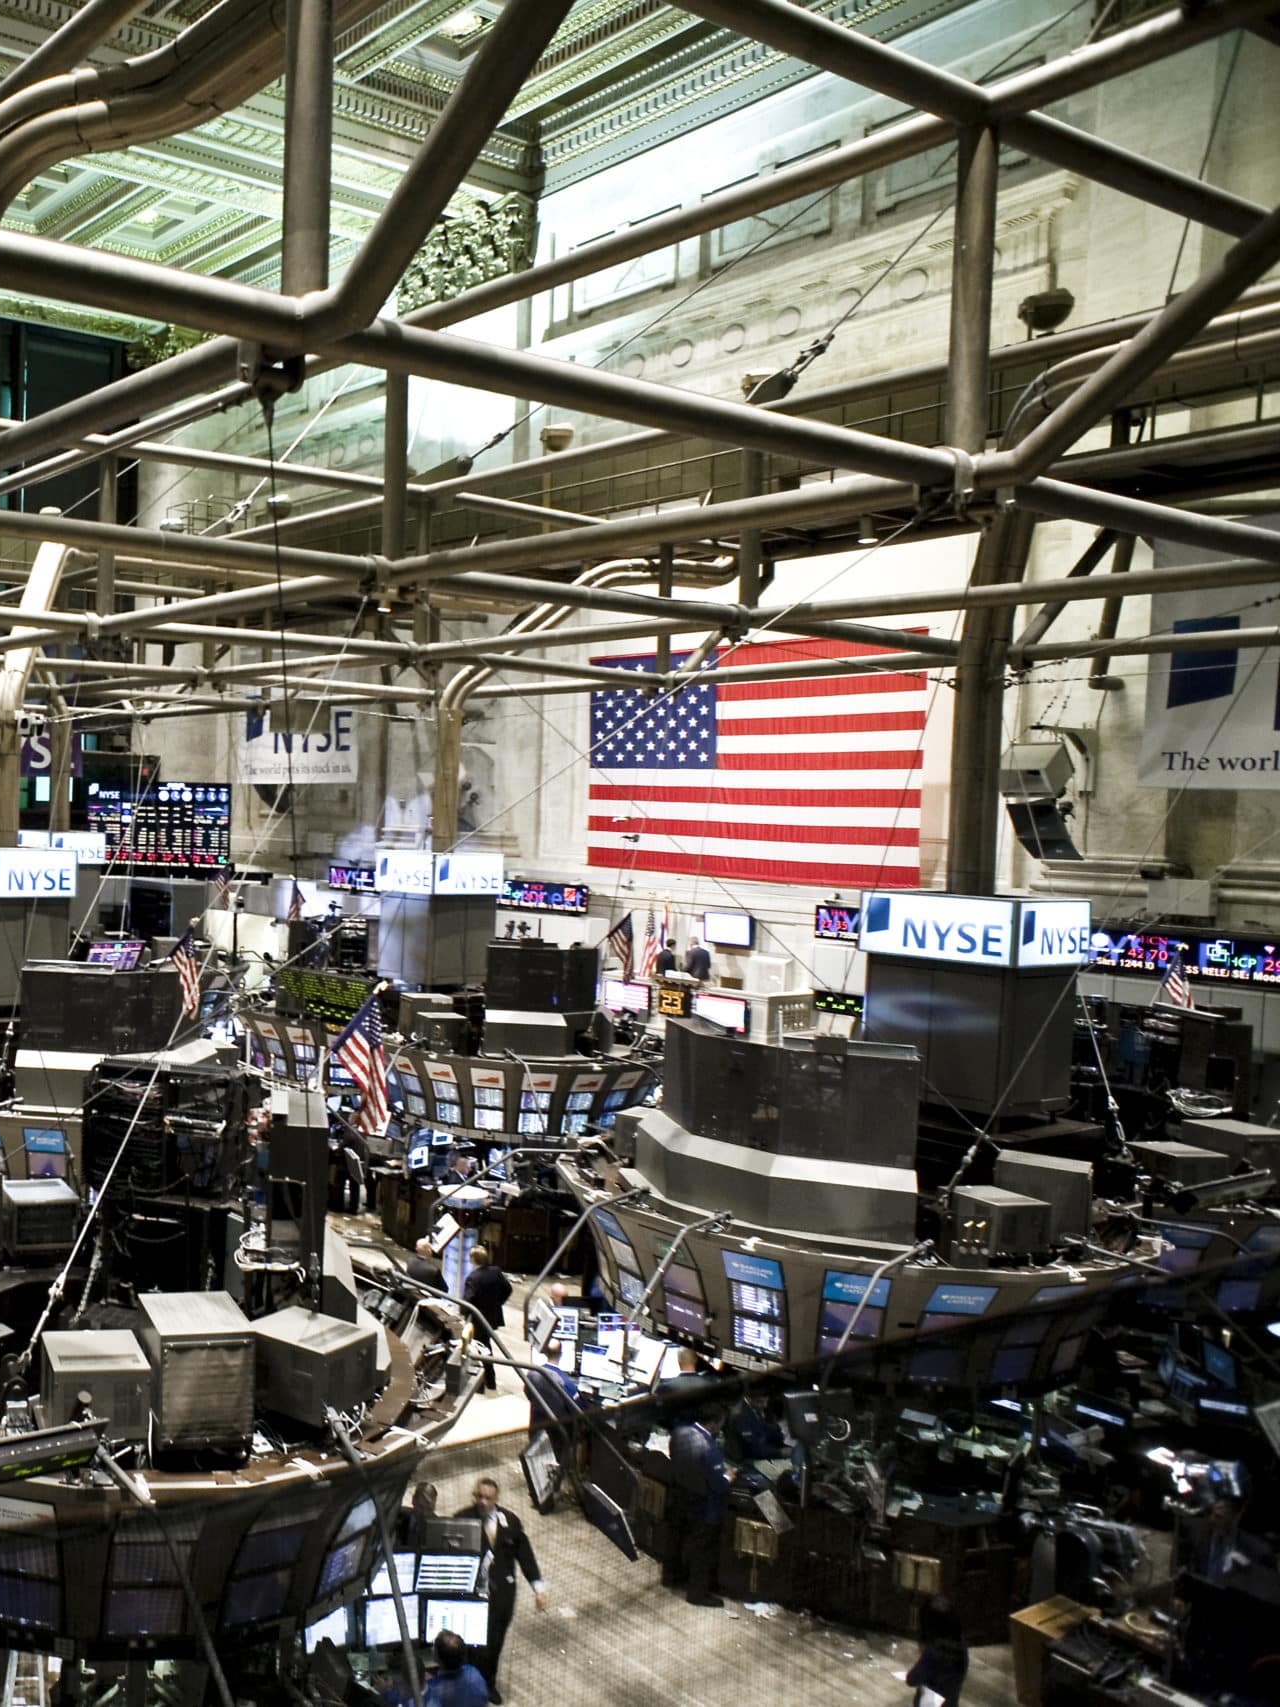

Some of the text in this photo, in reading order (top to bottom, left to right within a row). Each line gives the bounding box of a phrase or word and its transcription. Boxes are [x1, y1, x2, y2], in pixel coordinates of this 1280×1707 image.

[1161, 751, 1210, 771] The
[99, 790, 120, 799] NYSE
[79, 848, 105, 859] YSE
[8, 868, 71, 891] NYSE
[393, 869, 431, 888] NYSE
[455, 870, 499, 889] NYSE
[903, 917, 1003, 957] NYSE
[1040, 926, 1089, 955] NYSE
[662, 994, 681, 1010] 23
